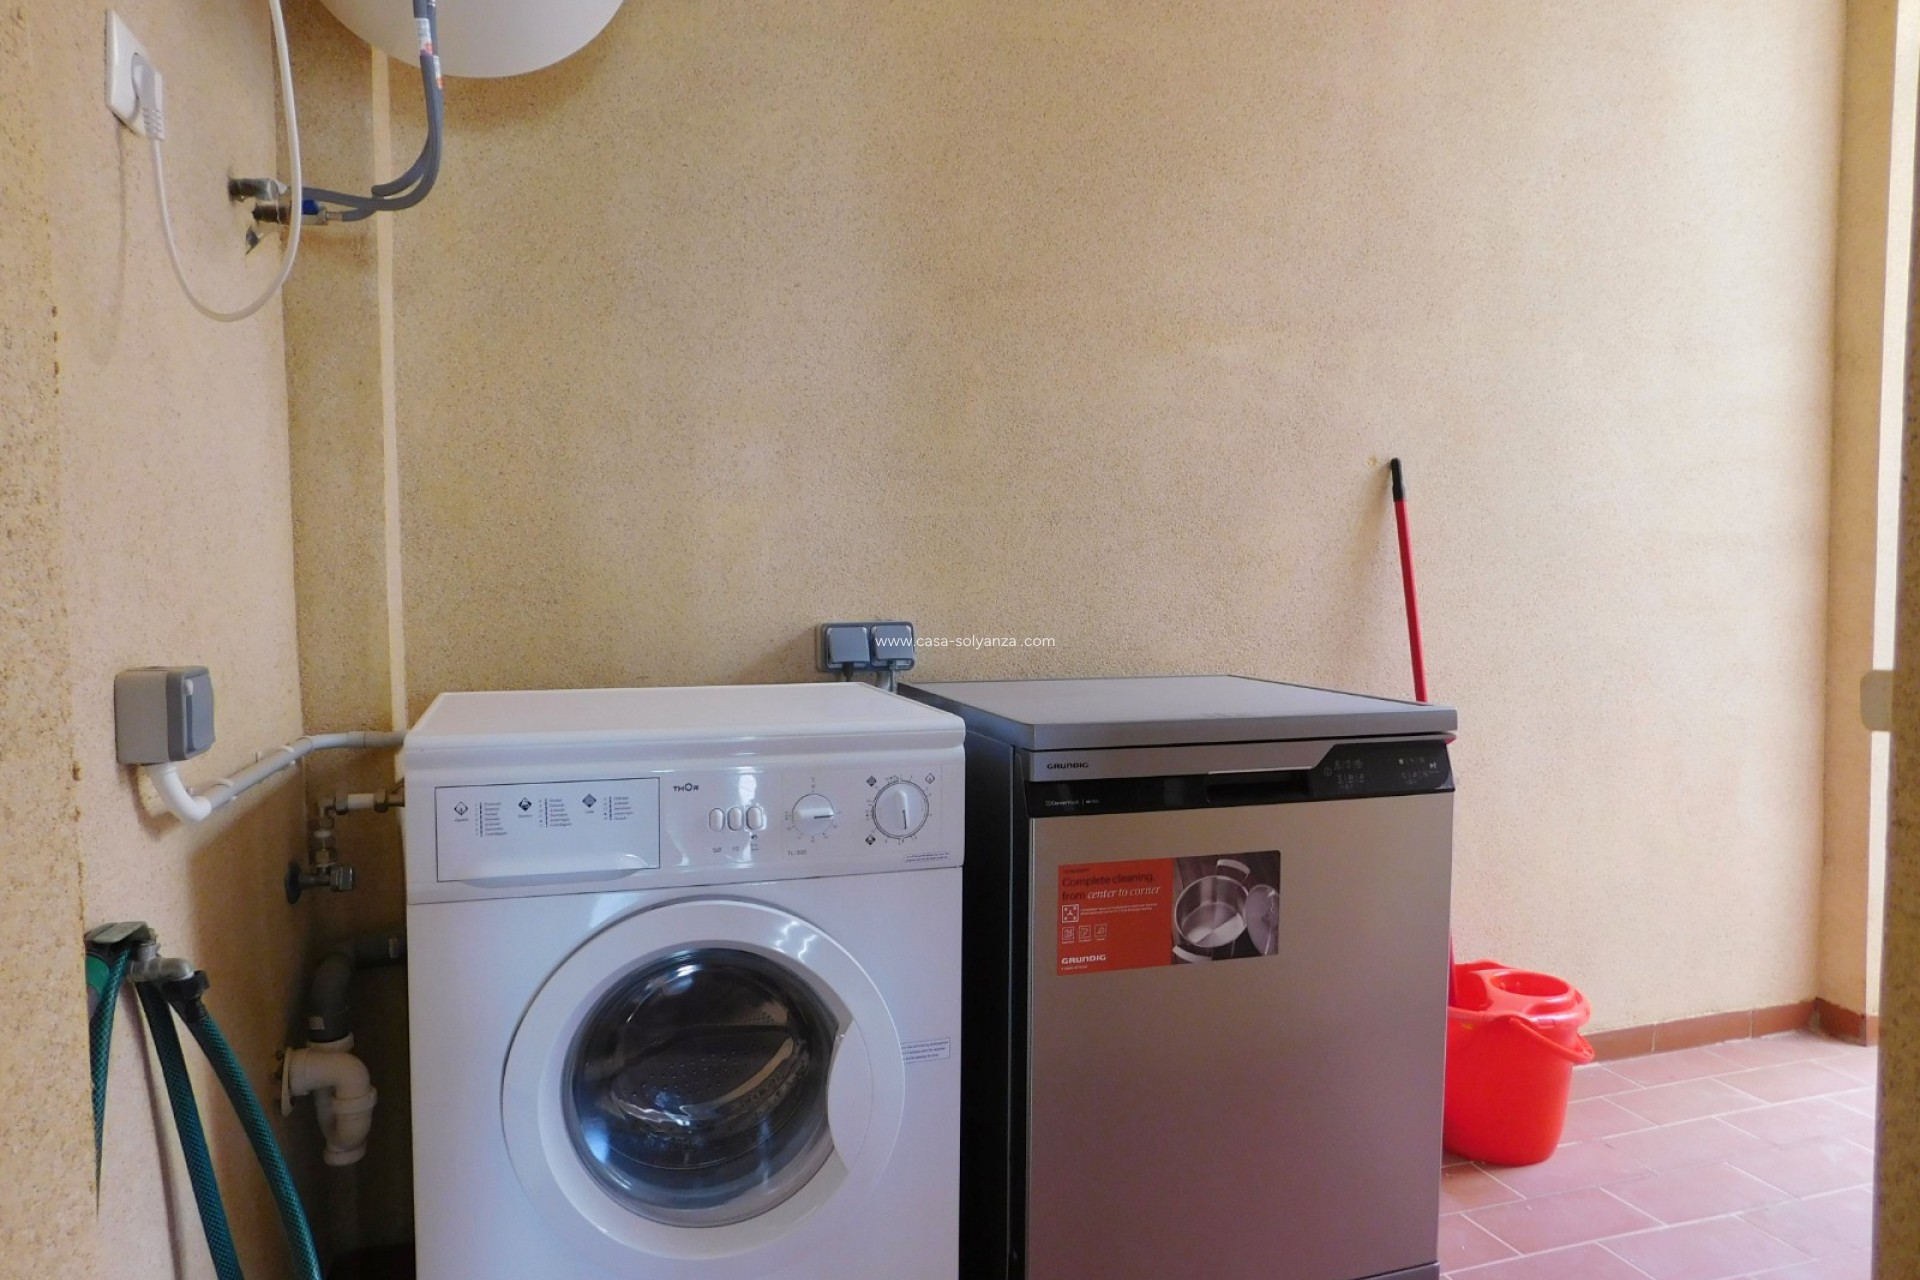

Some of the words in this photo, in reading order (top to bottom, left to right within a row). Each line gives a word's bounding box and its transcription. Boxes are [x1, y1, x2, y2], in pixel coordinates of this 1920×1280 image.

[1046, 761, 1089, 770] GRUNDIG
[672, 782, 699, 792] THOR
[1062, 875, 1110, 887] Complete
[1111, 872, 1153, 884] cleaning
[1062, 890, 1086, 901] from
[1087, 888, 1117, 900] center
[1118, 887, 1128, 897] to
[1129, 885, 1161, 897] corner
[1061, 954, 1107, 965] GRUNDIG
